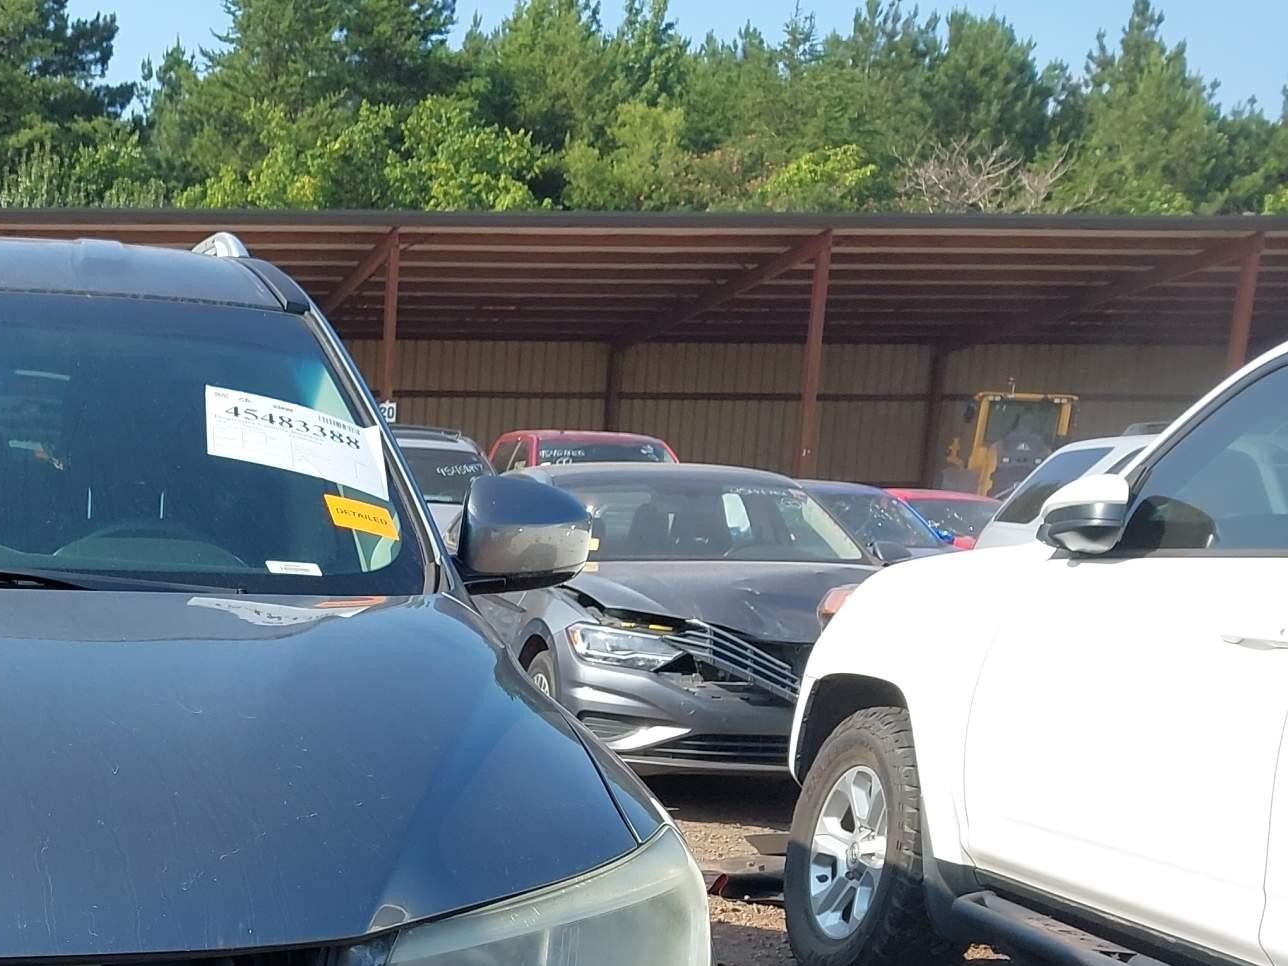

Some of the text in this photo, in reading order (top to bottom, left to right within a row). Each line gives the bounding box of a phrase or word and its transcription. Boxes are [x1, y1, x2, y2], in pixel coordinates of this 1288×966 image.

[380, 406, 395, 419] 20
[225, 406, 361, 449] 45483388
[335, 507, 388, 525] DETAILED
